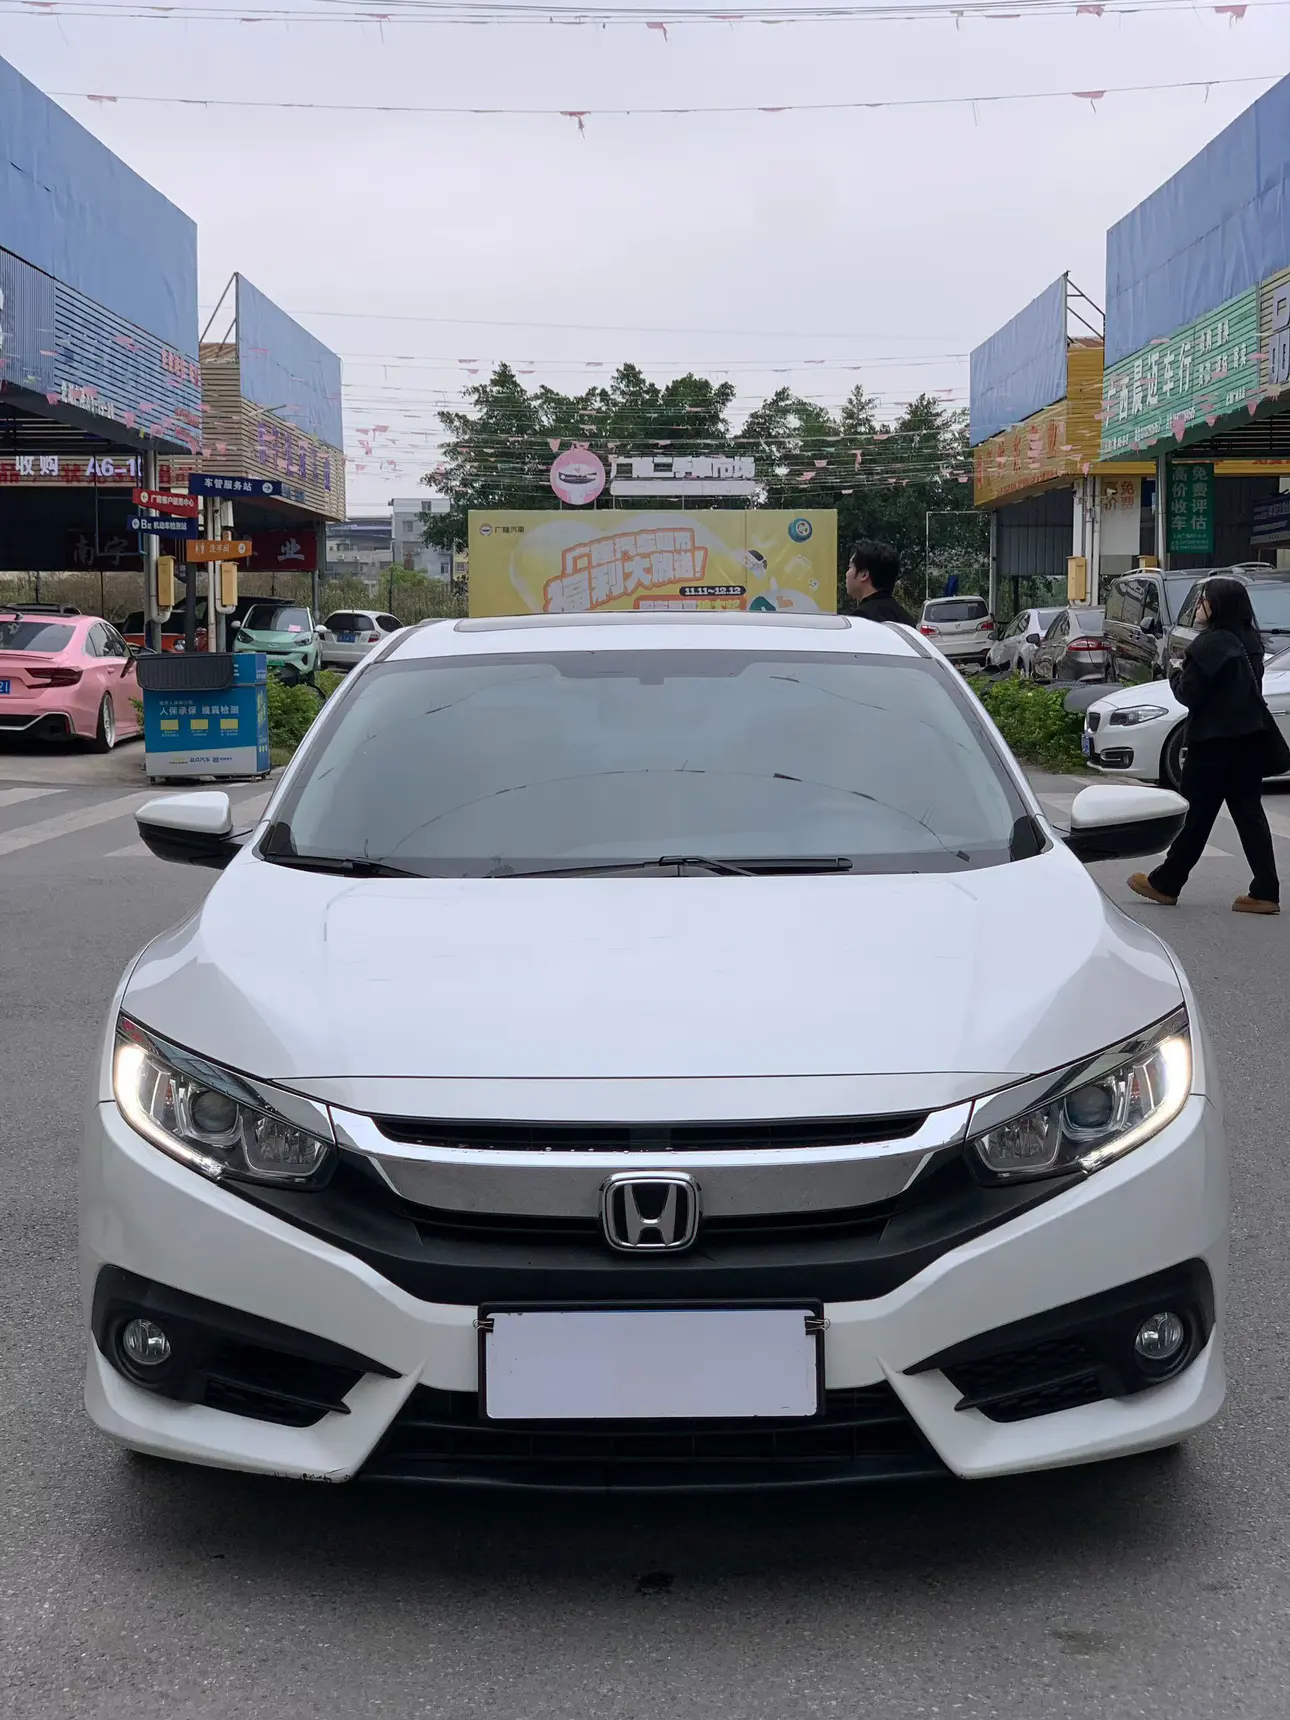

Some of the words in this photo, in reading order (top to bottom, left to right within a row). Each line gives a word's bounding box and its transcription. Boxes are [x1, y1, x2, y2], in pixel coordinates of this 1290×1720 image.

[15, 455, 59, 476] 收购
[86, 456, 142, 477] A6-1
[204, 478, 252, 492] 车管服务站
[1171, 466, 1188, 531] 高价收车
[1192, 466, 1208, 531] 免费评估
[277, 537, 305, 562] 业
[684, 586, 741, 596] 11.11~12.12
